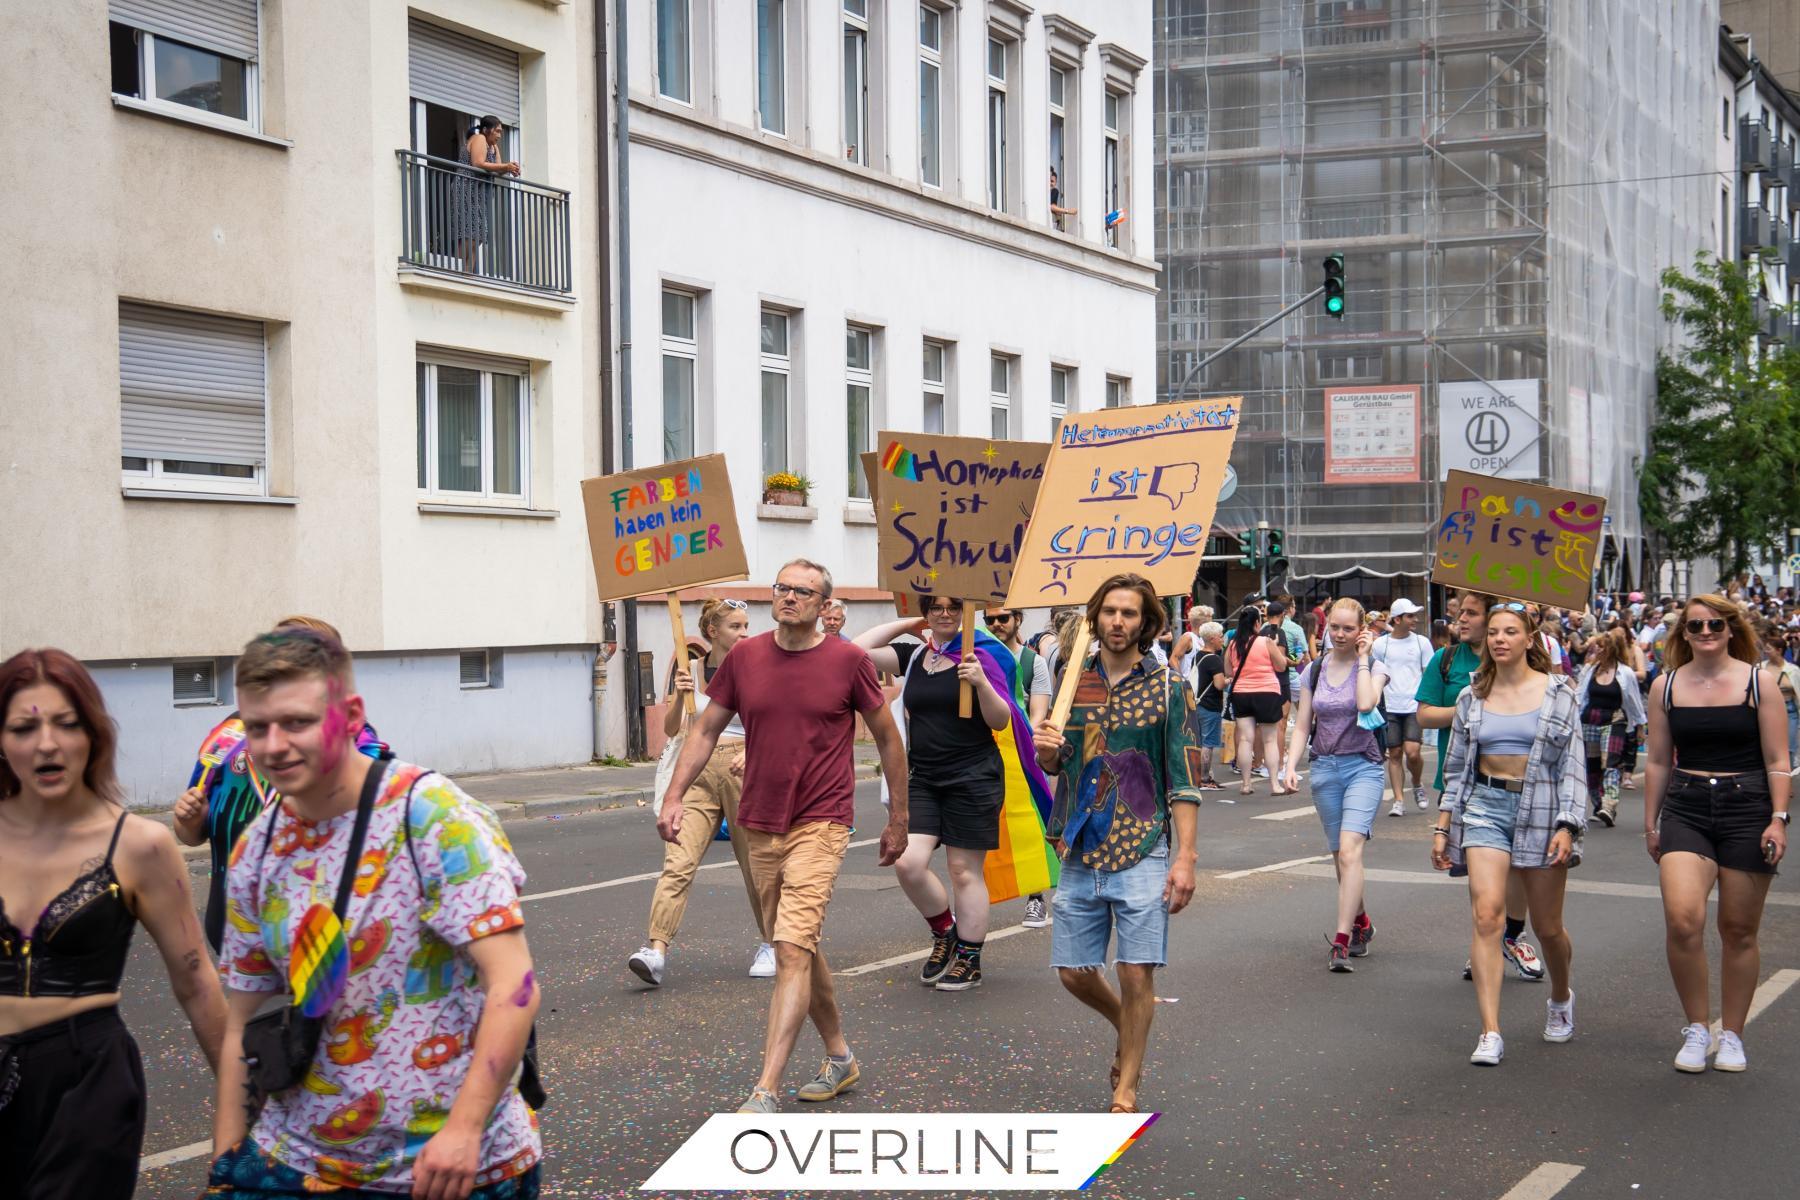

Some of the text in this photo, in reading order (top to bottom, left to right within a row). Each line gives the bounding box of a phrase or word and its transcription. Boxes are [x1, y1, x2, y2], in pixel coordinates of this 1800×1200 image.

[1461, 395, 1516, 410] WE ARE
[912, 449, 1044, 487] Homophob
[1091, 467, 1148, 496] ist
[1469, 457, 1509, 470] OPEN
[609, 467, 703, 512] FARBEN
[940, 491, 988, 514] ist
[1461, 486, 1541, 518] Pan
[614, 500, 702, 539] haben kein
[1490, 518, 1554, 556] ist
[615, 523, 724, 577] GENDER
[1050, 514, 1202, 567] cringe
